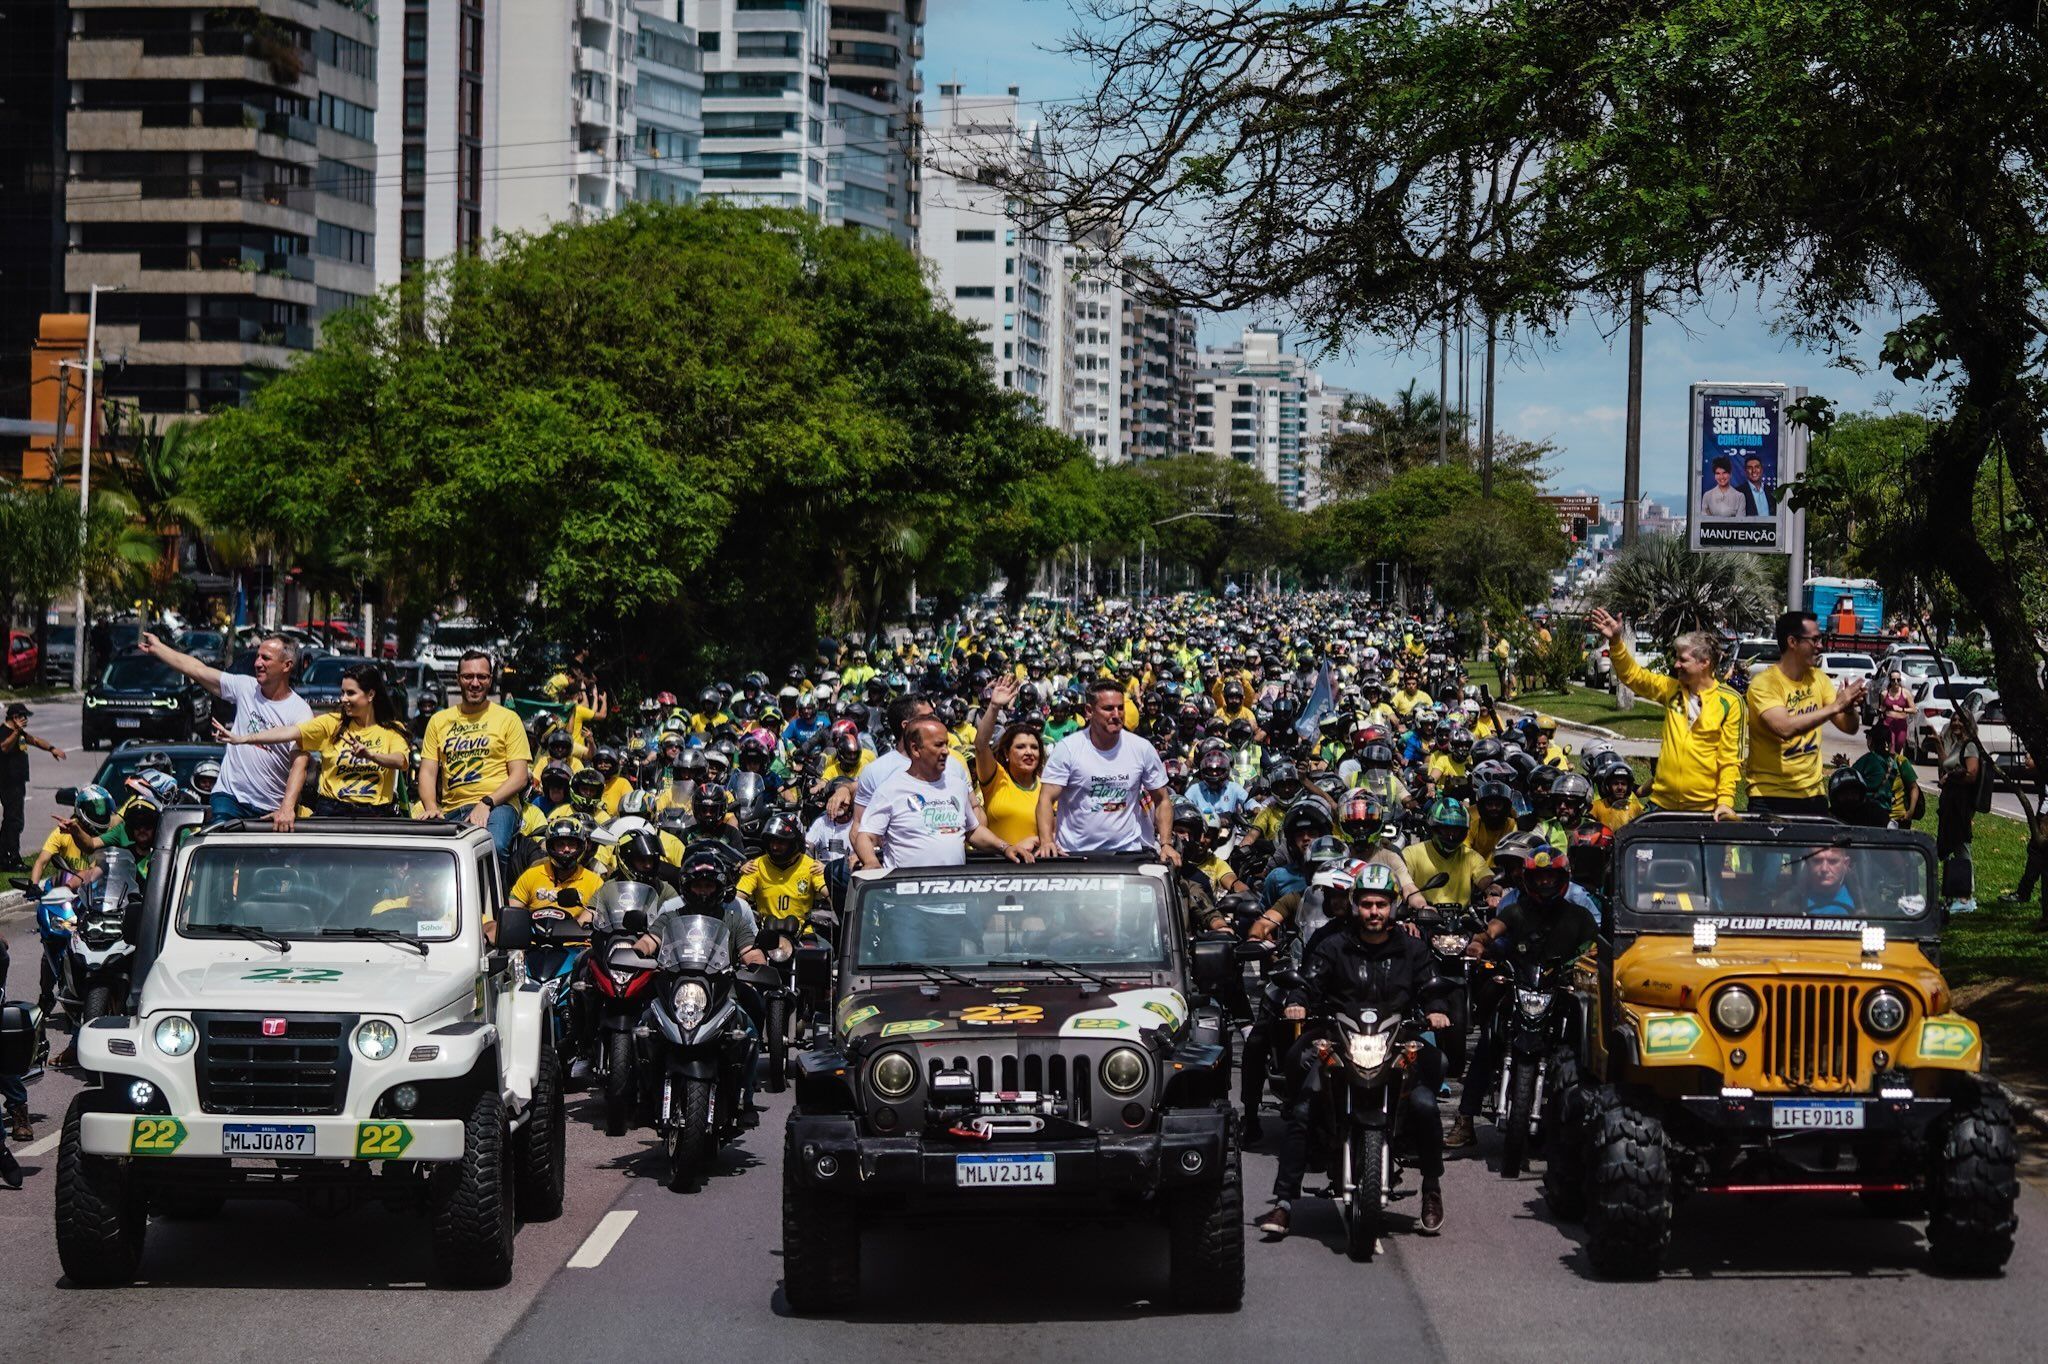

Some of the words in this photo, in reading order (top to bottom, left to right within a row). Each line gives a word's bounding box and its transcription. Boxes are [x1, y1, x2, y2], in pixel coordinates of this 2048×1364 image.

[1711, 406, 1728, 418] TEM
[1729, 406, 1749, 418] TUDO
[1750, 407, 1766, 419] PRA
[1713, 418, 1737, 435] SER
[1739, 418, 1771, 435] MAIS
[1718, 435, 1763, 446] CONECTADA
[1700, 528, 1776, 543] MANUTENÇÃO
[447, 721, 479, 736] Agora
[443, 735, 490, 755] Flávio
[446, 748, 490, 765] Bolsonaro
[447, 757, 484, 787] 22
[338, 772, 380, 798] 22
[920, 879, 1101, 894] TRANSCATARINA
[778, 895, 790, 910] 10
[1730, 918, 1764, 930] CLUB
[1766, 918, 1812, 931] PEDRA
[1814, 920, 1868, 932] BRANCA
[240, 968, 344, 982] 22
[961, 1005, 1044, 1021] 22
[888, 1022, 929, 1034] 22
[1078, 1019, 1120, 1030] 22
[1650, 1020, 1691, 1048] 22
[1923, 1025, 1965, 1052] 22
[1782, 1109, 1854, 1126] IFE9D18
[135, 1120, 178, 1149] 22
[360, 1125, 403, 1154] 22
[966, 1164, 1044, 1182] MLV2J14
